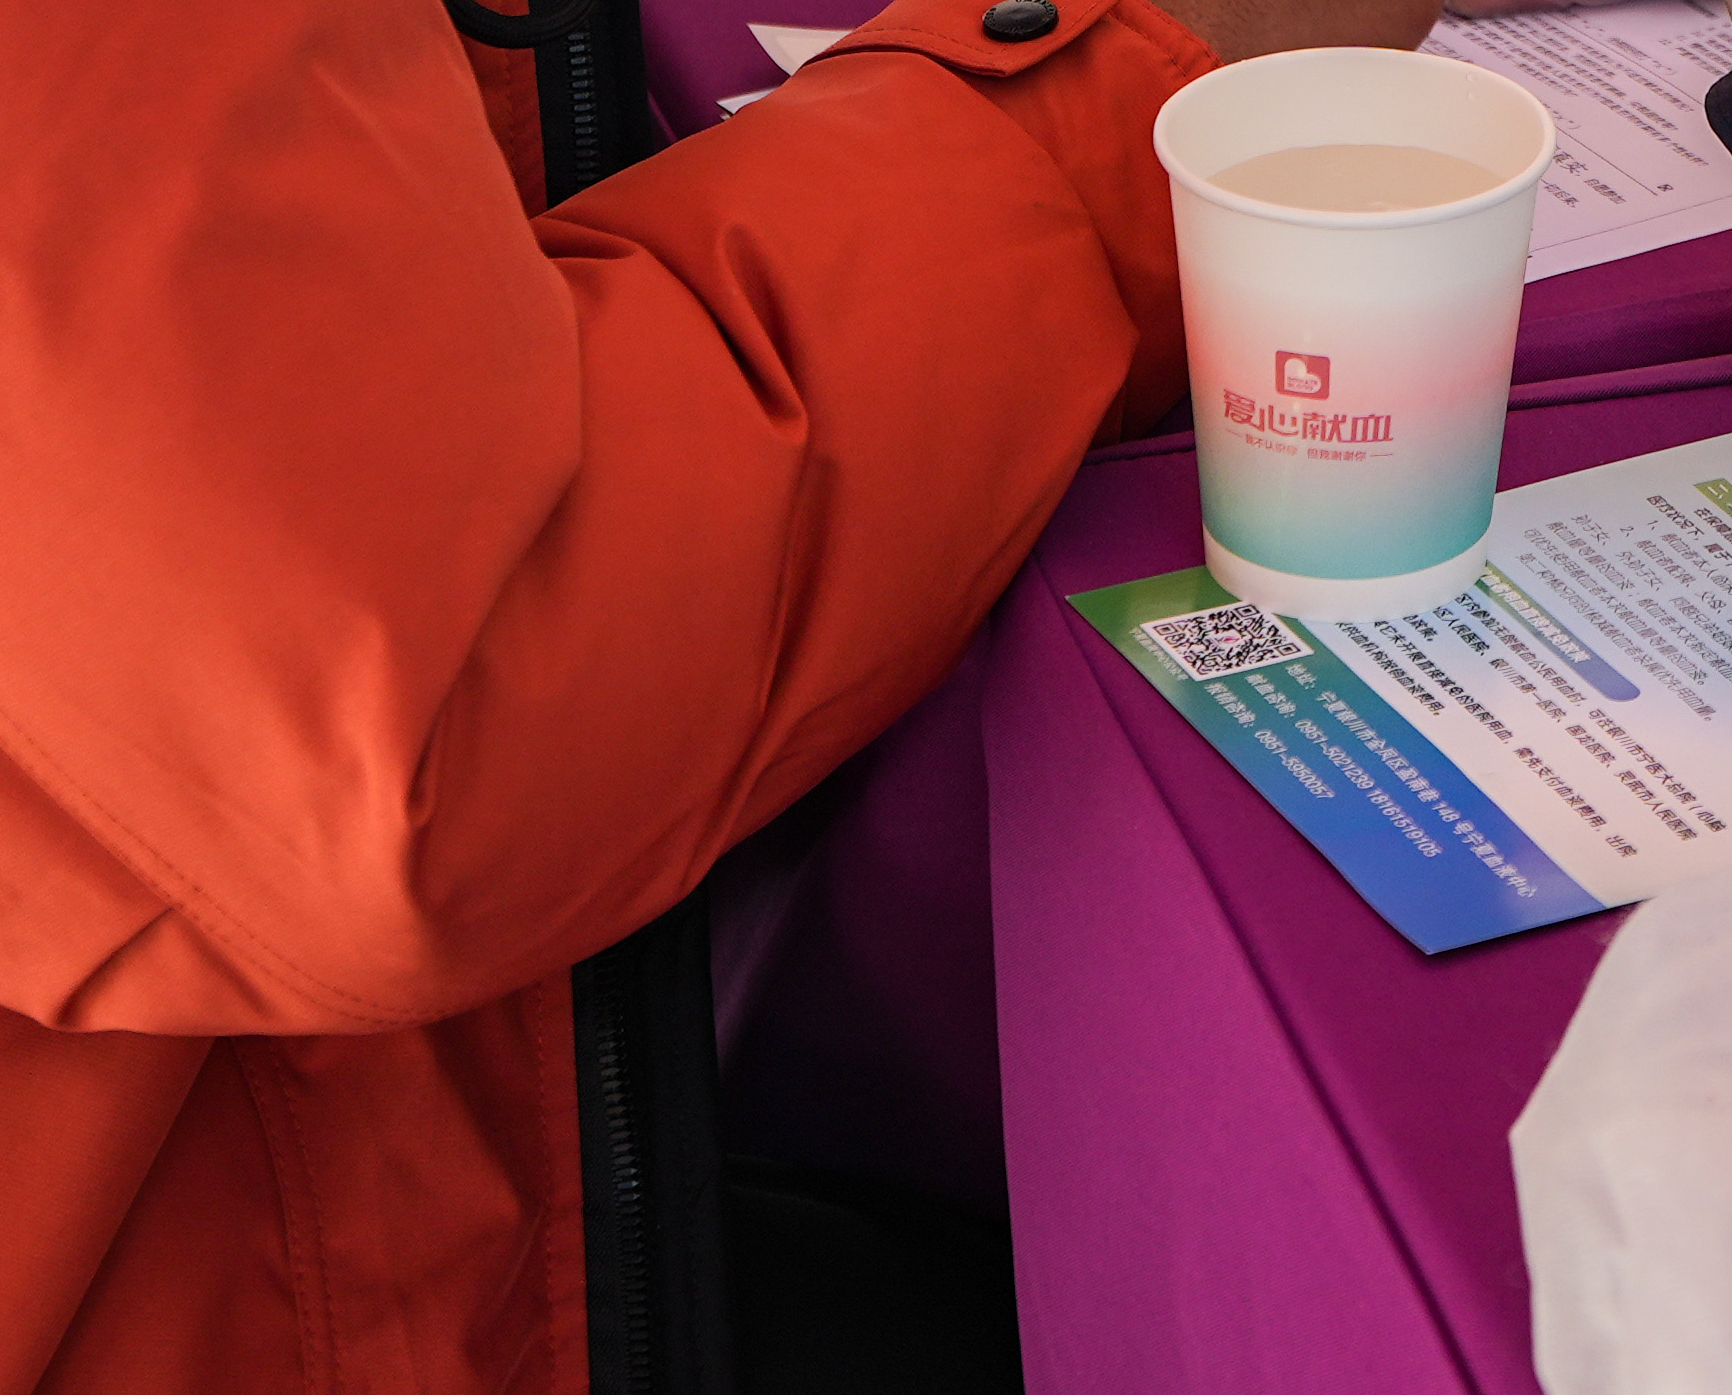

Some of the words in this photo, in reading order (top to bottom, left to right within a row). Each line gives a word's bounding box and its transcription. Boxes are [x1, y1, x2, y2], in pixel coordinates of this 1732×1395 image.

[1222, 388, 1394, 444] 爱心献血
[1429, 605, 1699, 842] 区人民医院、银川市第一医院、国龙医院、灵武市人民医院
[1363, 787, 1443, 858] 18161519105
